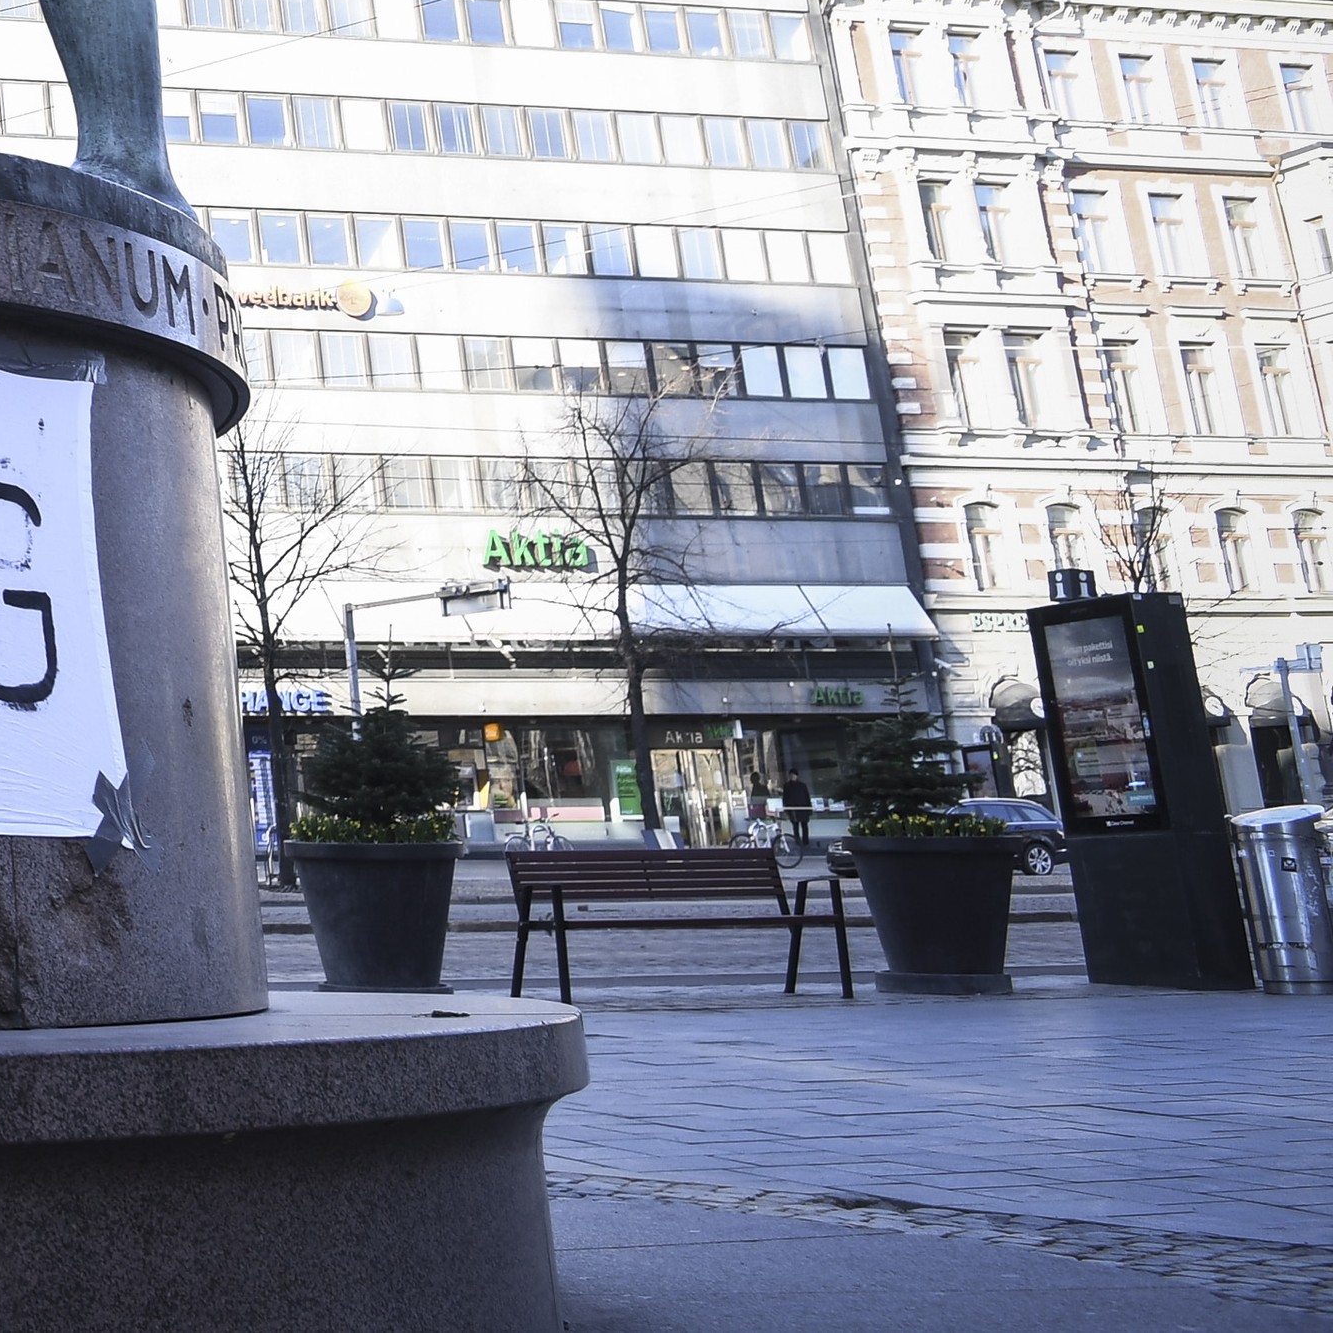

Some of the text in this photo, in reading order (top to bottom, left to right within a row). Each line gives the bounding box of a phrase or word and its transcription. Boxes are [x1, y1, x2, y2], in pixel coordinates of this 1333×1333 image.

[236, 285, 335, 310] wedbank
[483, 529, 590, 567] Aktia
[971, 612, 1030, 632] ESPRE
[241, 690, 328, 712] HANGE
[810, 686, 865, 705] Aktia
